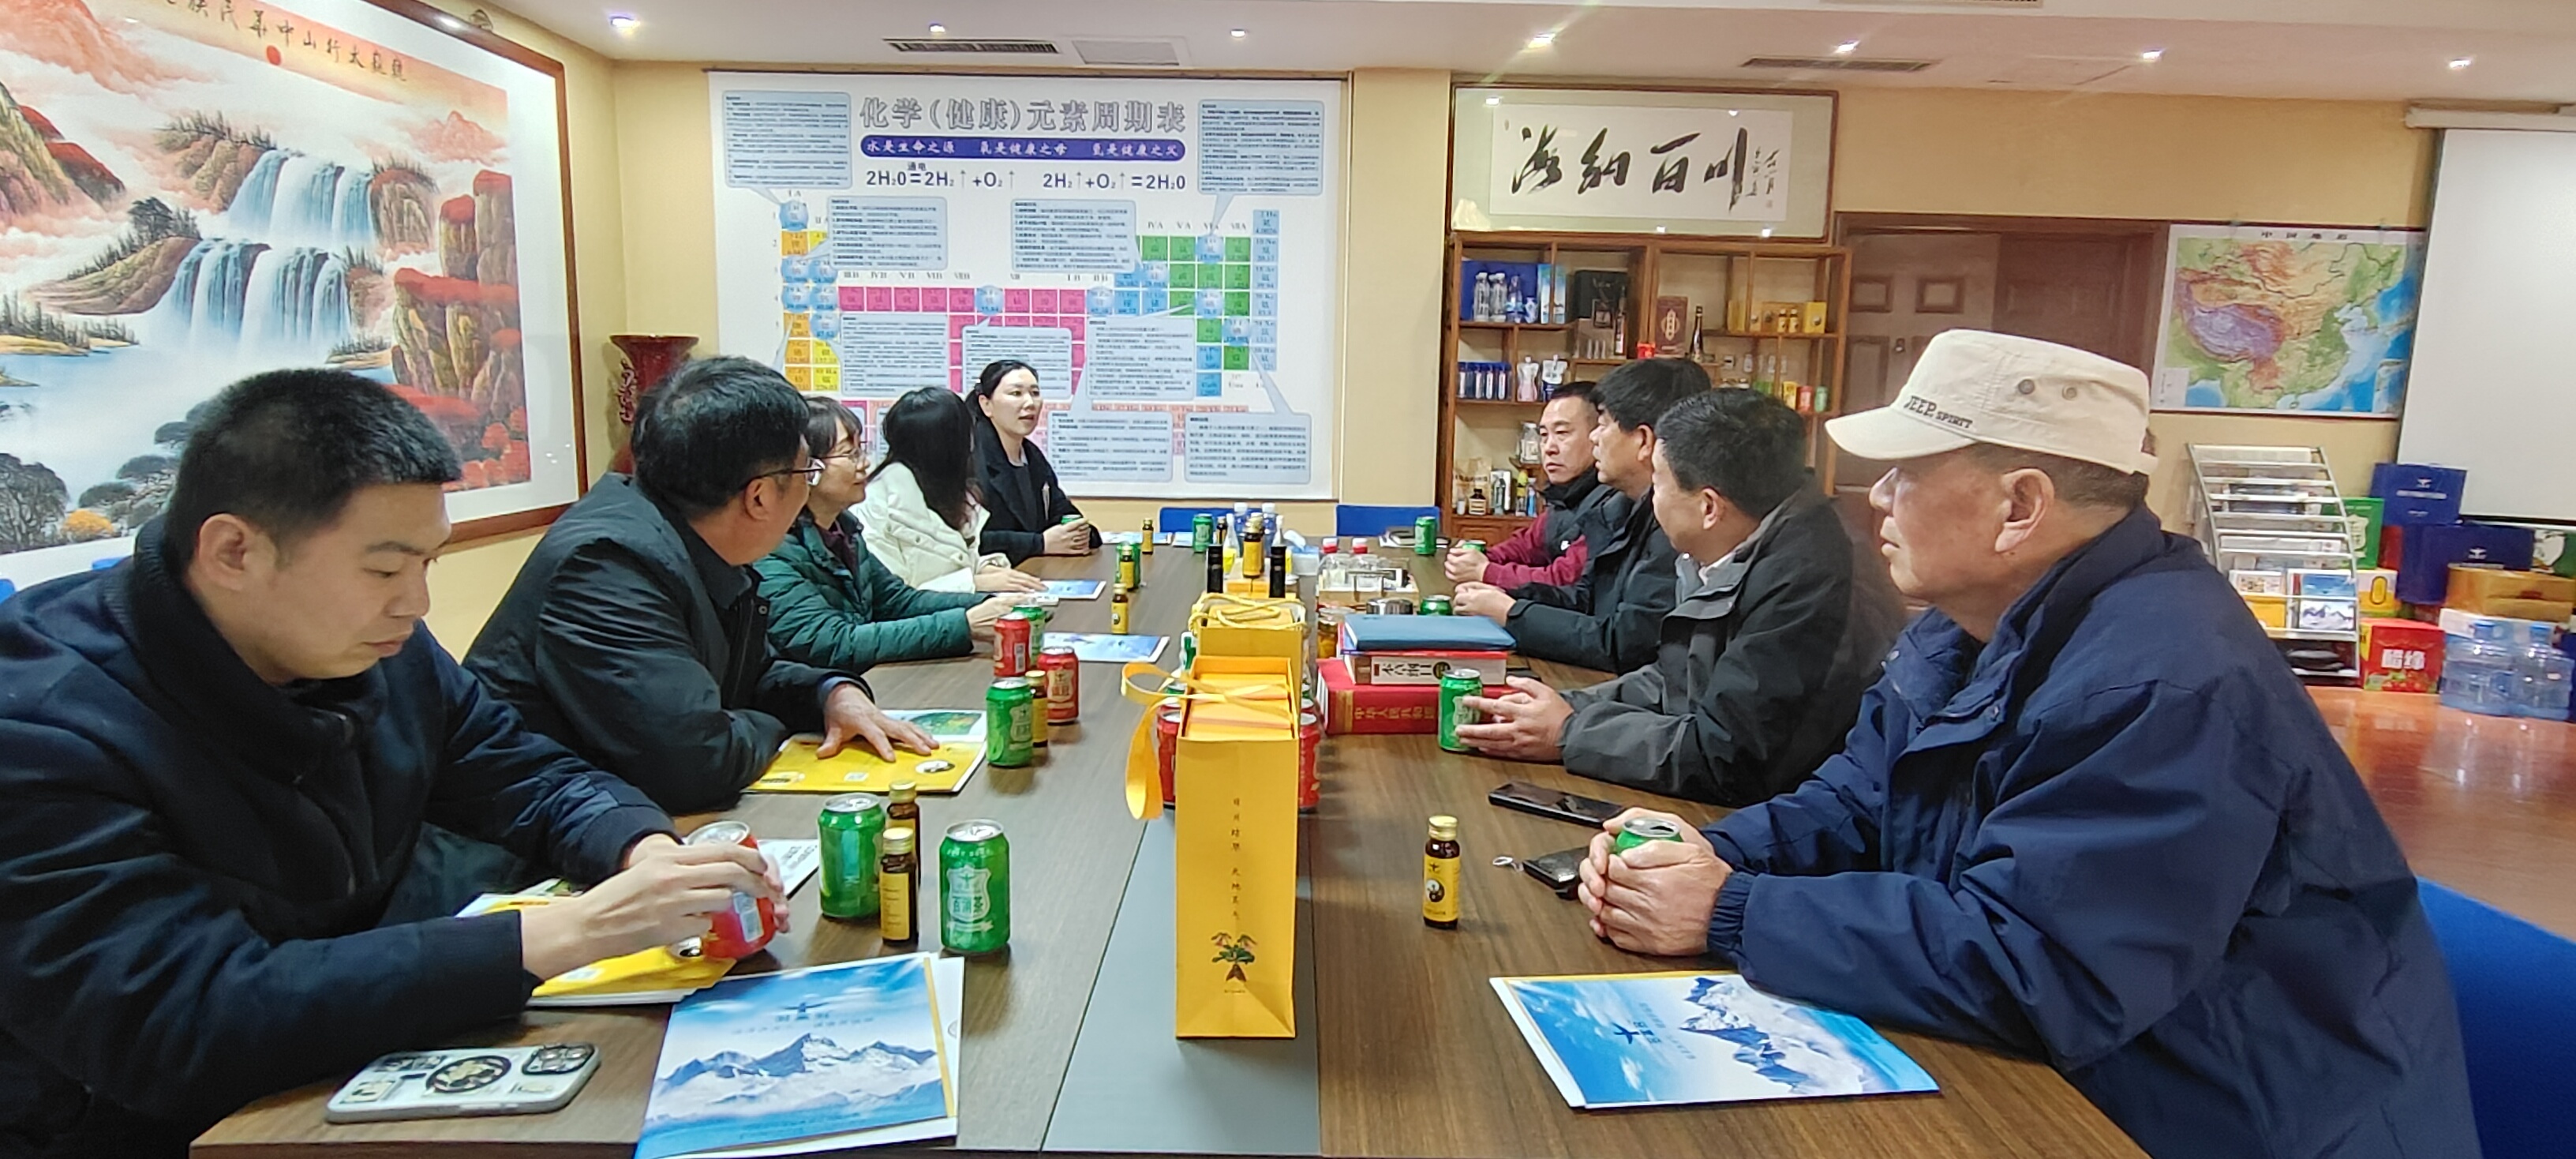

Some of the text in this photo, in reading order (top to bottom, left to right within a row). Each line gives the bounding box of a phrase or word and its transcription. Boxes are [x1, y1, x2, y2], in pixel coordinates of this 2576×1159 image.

[859, 97, 1186, 133] 化学(健康)元素周期表
[866, 139, 956, 155] 水是生命之源
[1935, 411, 1973, 429] SPIRIT
